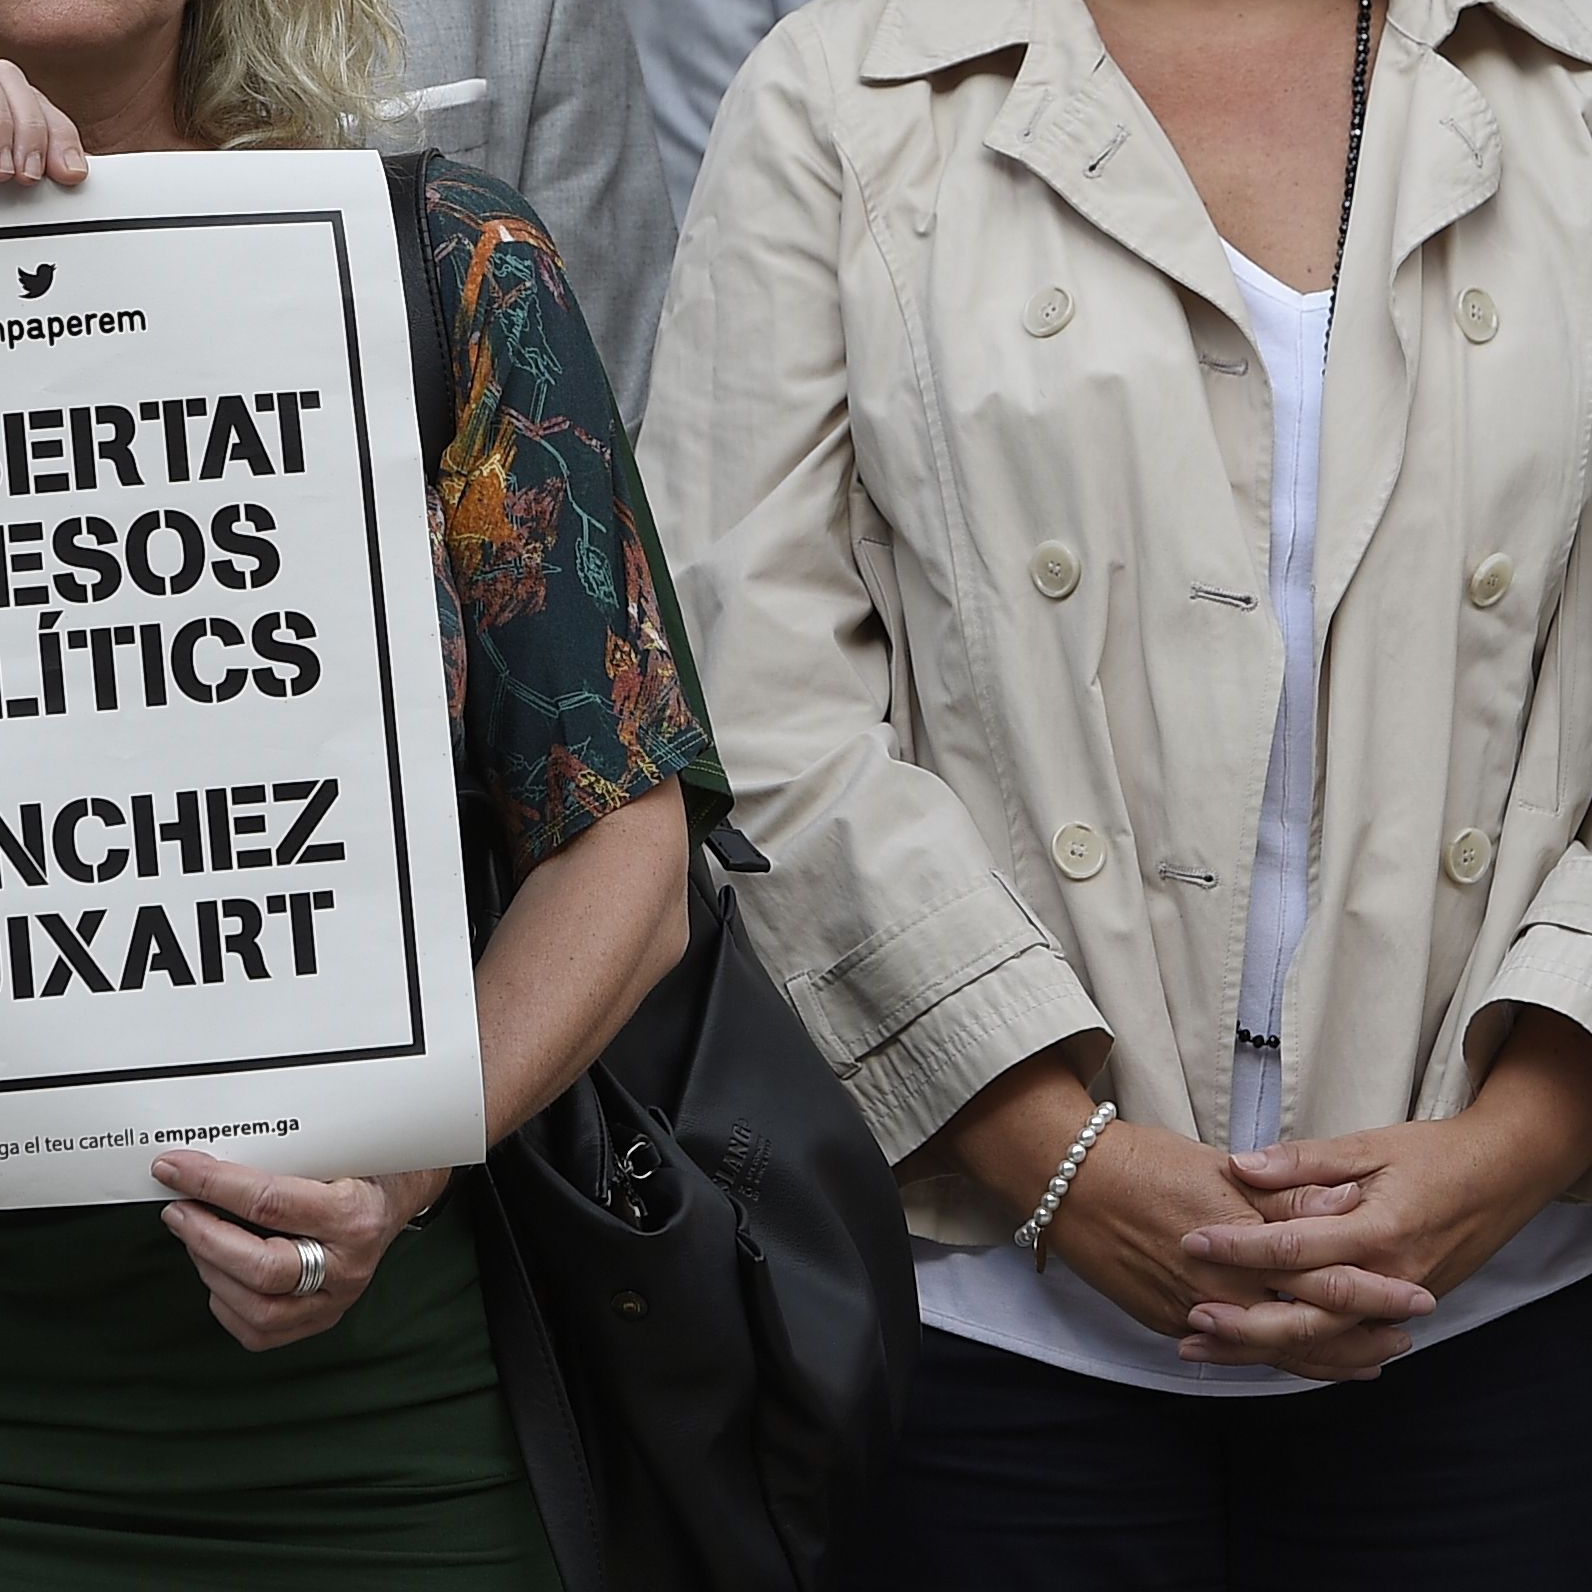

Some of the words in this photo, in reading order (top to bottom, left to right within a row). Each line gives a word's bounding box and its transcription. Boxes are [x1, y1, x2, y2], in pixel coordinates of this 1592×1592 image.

[24, 1136, 41, 1154] el
[45, 1136, 75, 1152] teu
[79, 1127, 135, 1150] cartell
[139, 1131, 150, 1145] a
[154, 1118, 300, 1146] empaperem.ga
